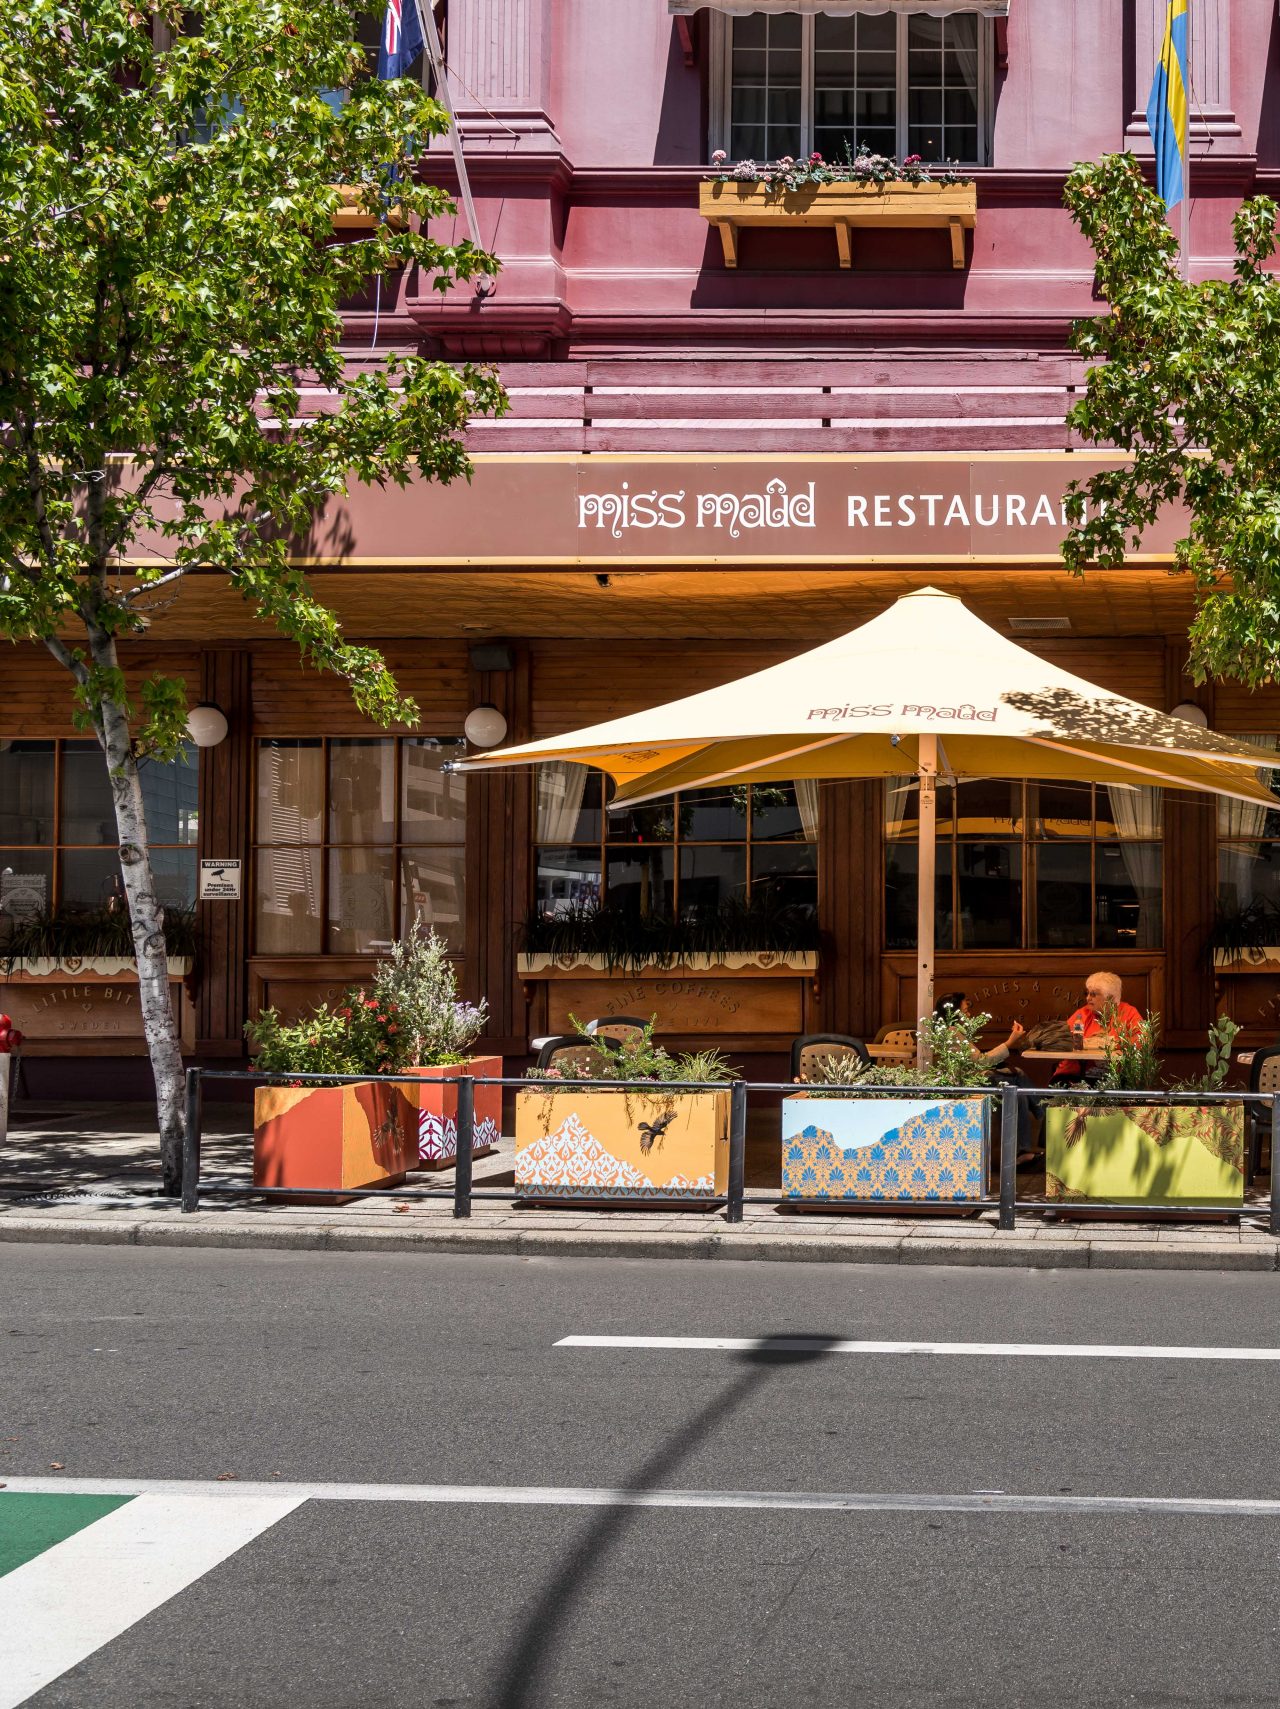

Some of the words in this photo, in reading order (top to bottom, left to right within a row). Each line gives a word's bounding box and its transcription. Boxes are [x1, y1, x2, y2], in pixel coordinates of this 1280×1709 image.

[847, 494, 1107, 528] RESTAURAN
[31, 986, 92, 1013] LITTLE
[104, 987, 134, 1005] BIT
[605, 986, 647, 1016] FINE
[655, 981, 744, 1014] COFFEES
[973, 980, 1020, 1002] TRIES
[56, 1021, 121, 1031] SWEDEN
